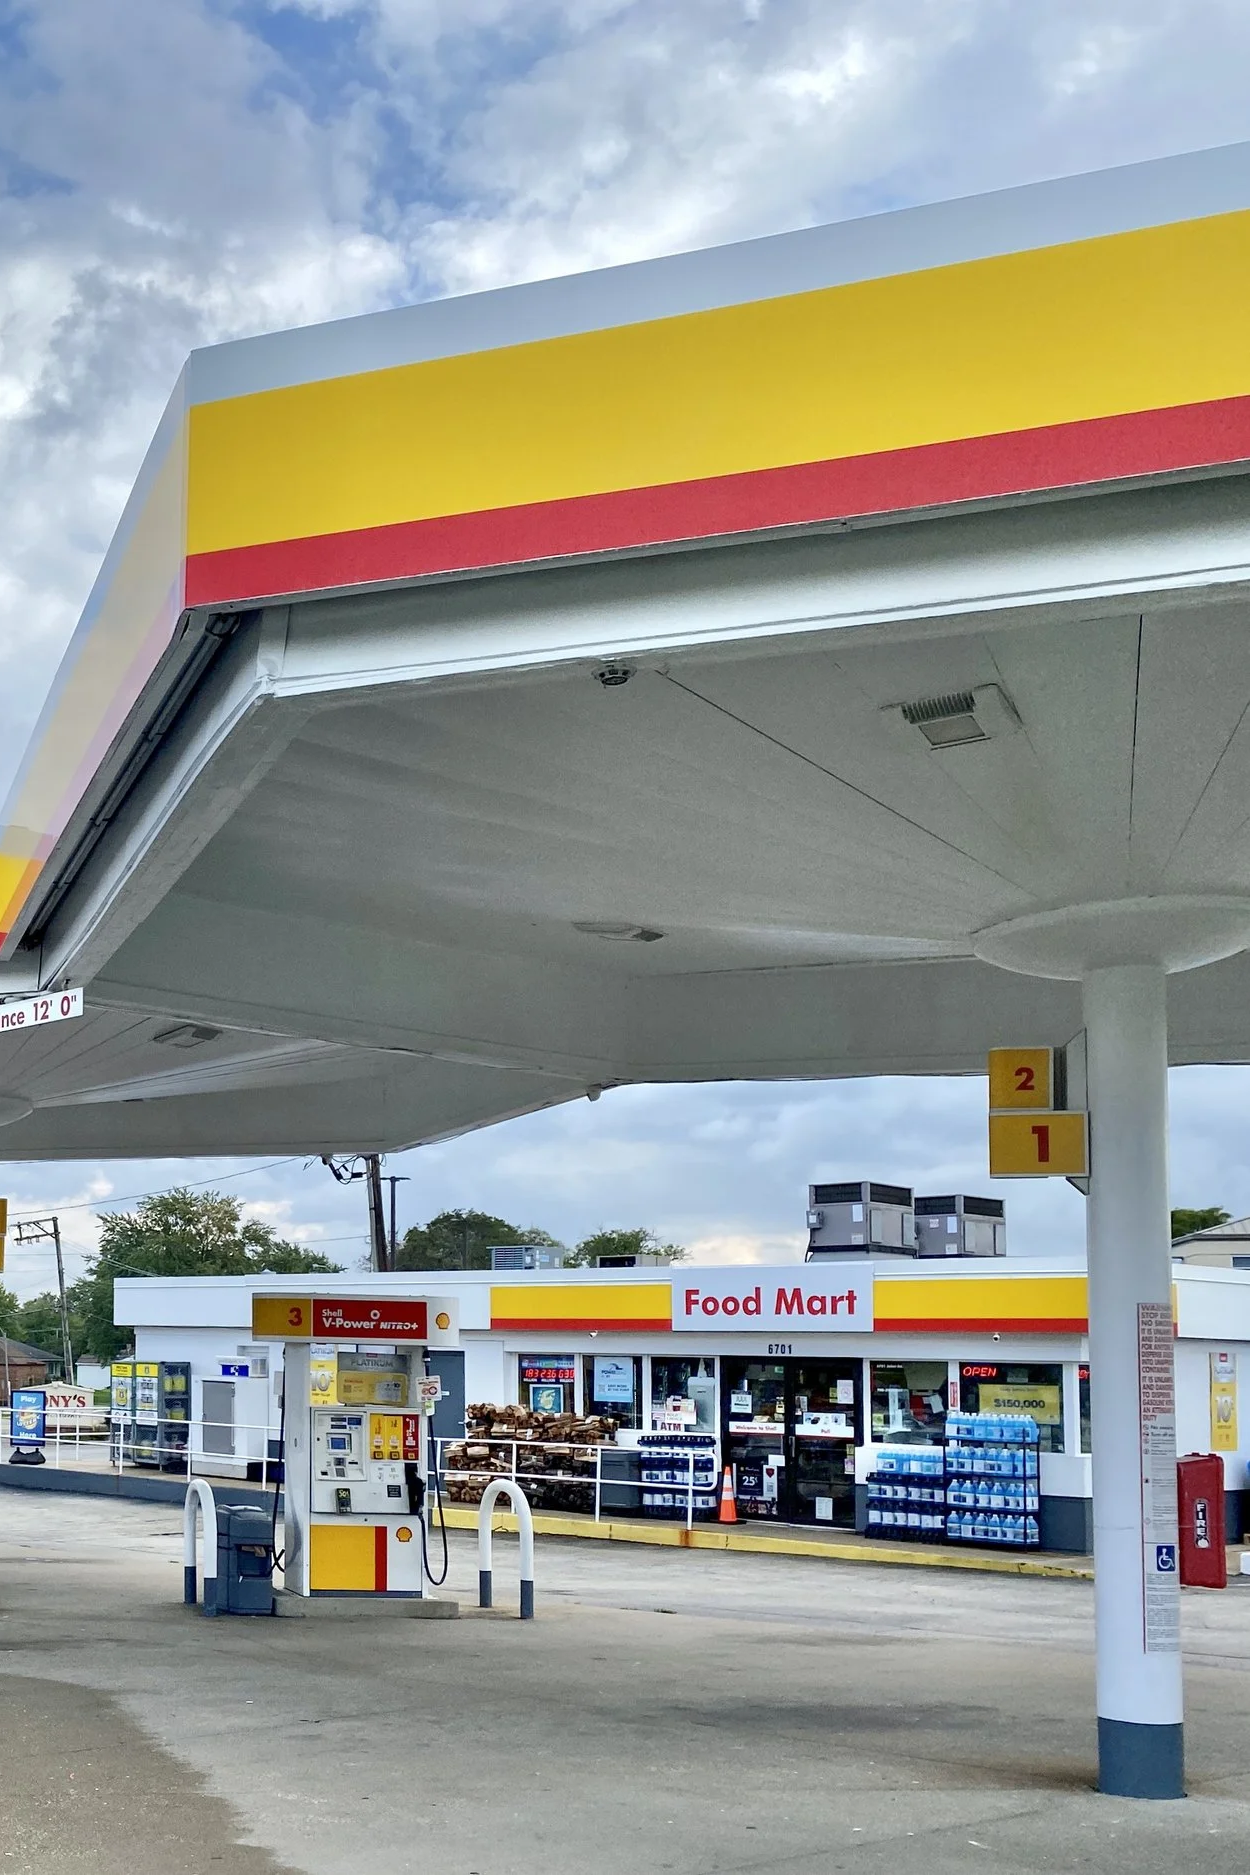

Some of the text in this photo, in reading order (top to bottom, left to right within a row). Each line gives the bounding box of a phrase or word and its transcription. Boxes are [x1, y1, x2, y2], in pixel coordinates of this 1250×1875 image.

[33, 1000, 52, 1021] 12'
[60, 995, 77, 1016] 0"
[1014, 1067, 1035, 1091] 2
[1031, 1125, 1049, 1162] 1
[685, 1286, 857, 1316] Food Mart
[288, 1307, 303, 1326] 3
[322, 1309, 343, 1317] Shell
[322, 1317, 419, 1330] V-Power NITRO+
[768, 1344, 792, 1354] 6701
[351, 1358, 394, 1368] PLATINUM
[525, 1369, 540, 1378] 183
[540, 1369, 557, 1379] 236
[963, 1366, 997, 1377] OPEN
[21, 1395, 37, 1403] Play
[994, 1399, 1046, 1410] $150,000
[660, 1421, 681, 1431] ATM
[1196, 1503, 1206, 1535] FIRE
